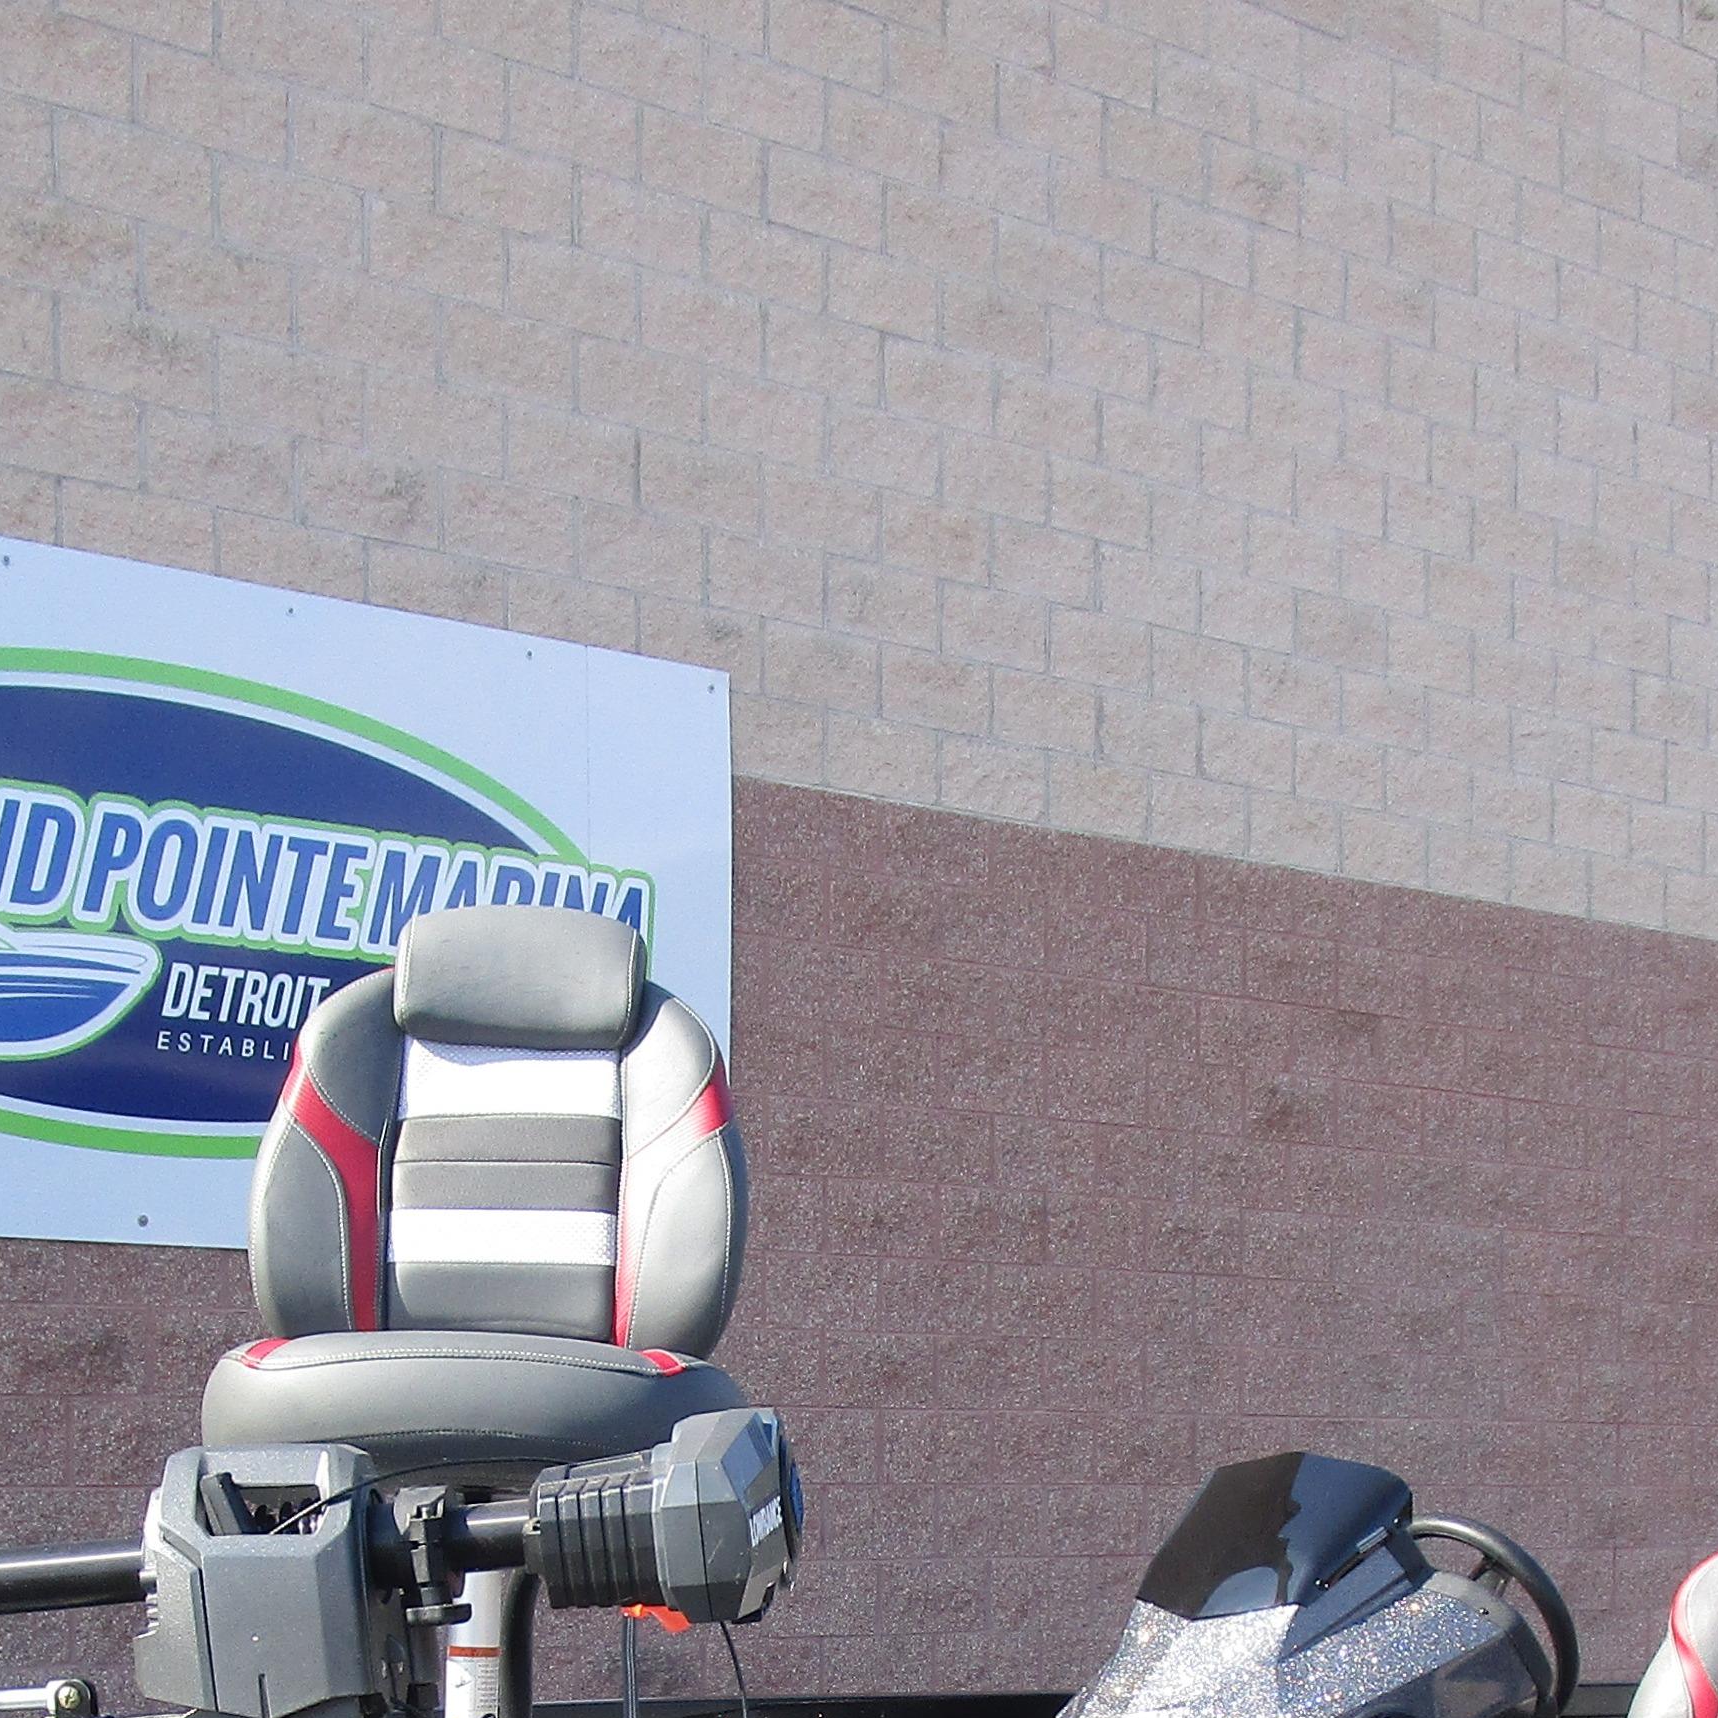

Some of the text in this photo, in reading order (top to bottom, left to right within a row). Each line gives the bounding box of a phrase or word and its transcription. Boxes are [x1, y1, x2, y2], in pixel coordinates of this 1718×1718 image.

[81, 811, 368, 942] POINTE
[161, 962, 331, 1030] DETROIT
[157, 1031, 290, 1061] ESTABLI
